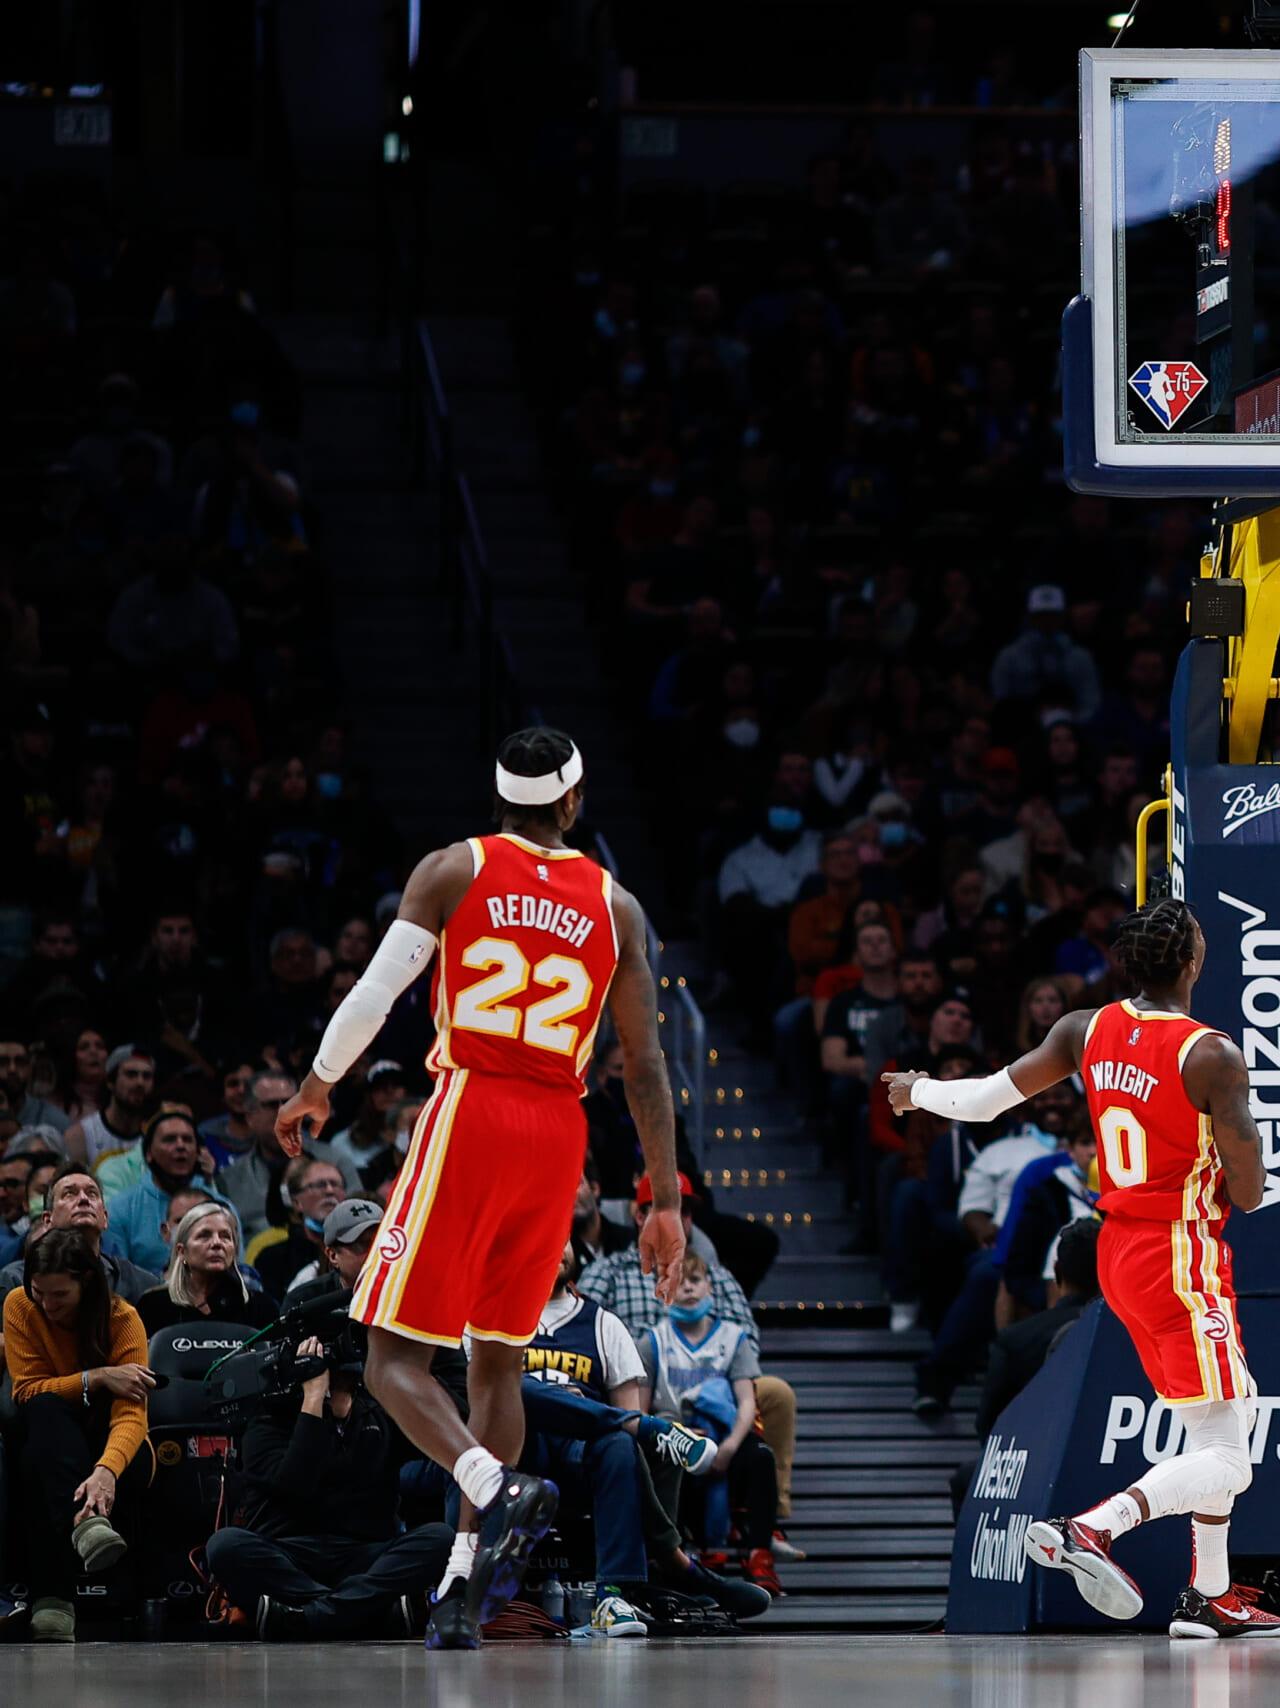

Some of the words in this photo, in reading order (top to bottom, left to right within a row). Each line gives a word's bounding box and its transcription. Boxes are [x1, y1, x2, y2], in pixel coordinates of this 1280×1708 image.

[1174, 371, 1191, 393] 75
[486, 894, 595, 949] REDDISH
[451, 936, 594, 1057] 22
[1090, 1060, 1159, 1103] WRIGHT
[1098, 1105, 1148, 1190] 0
[973, 1434, 1028, 1500] Western
[970, 1505, 1007, 1581] Union
